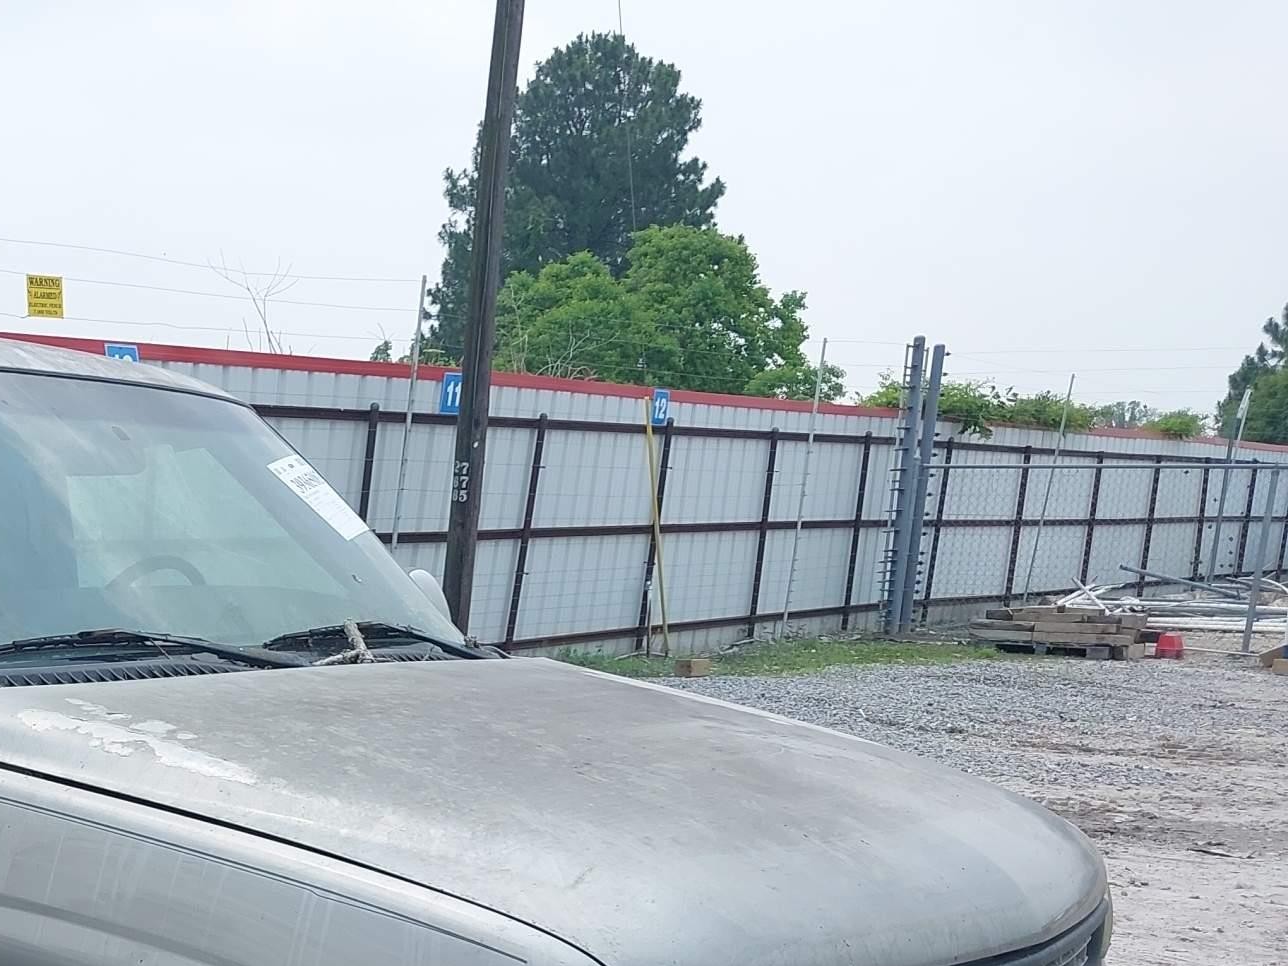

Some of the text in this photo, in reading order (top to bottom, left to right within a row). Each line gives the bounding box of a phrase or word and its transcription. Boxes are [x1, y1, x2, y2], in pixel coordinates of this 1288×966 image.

[28, 277, 60, 287] WARNING
[447, 381, 462, 407] 11
[654, 397, 667, 419] 12
